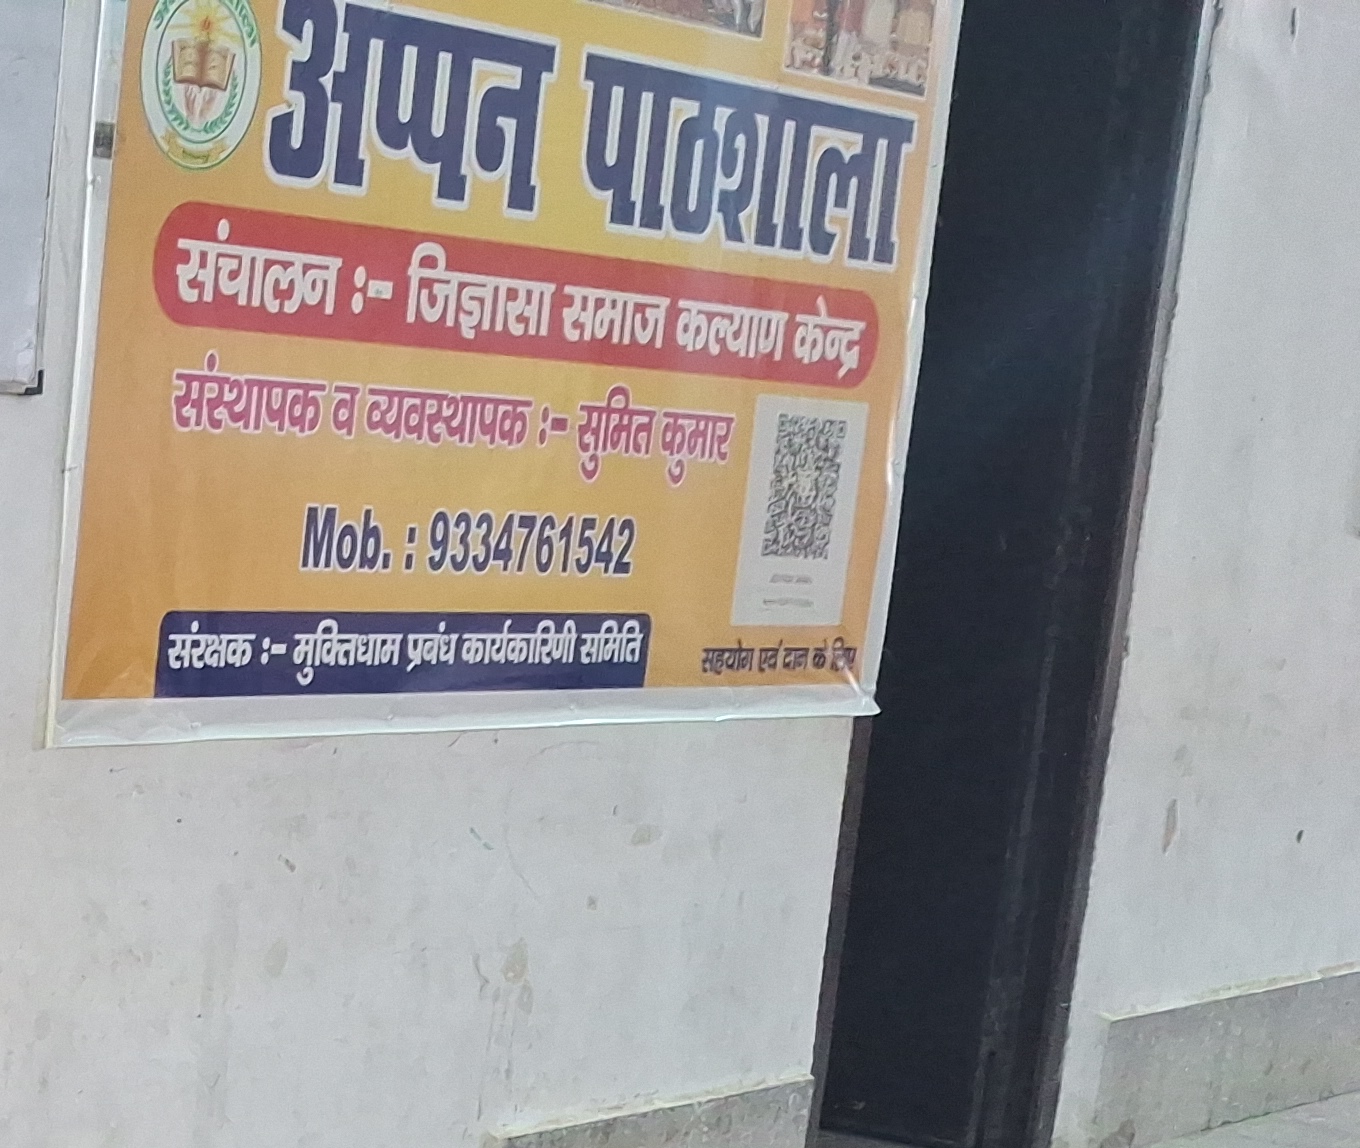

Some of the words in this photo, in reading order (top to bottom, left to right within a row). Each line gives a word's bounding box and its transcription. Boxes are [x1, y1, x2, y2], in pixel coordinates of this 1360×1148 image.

[266, 0, 558, 214] अप्पन
[581, 50, 918, 267] पाठशाला
[176, 217, 343, 316] संचालन
[405, 241, 557, 339] जिज्ञासा
[562, 284, 672, 349] समाज
[676, 299, 789, 362] कल्याण
[793, 294, 867, 380] केन्द्र
[173, 350, 329, 436] संस्थापक
[330, 382, 362, 438] व
[365, 385, 534, 449] व्यवस्थापक
[577, 382, 658, 483] सुमित
[659, 410, 736, 487] कुमार
[299, 504, 393, 572] Mob.
[427, 509, 637, 576] 9334761542
[167, 620, 257, 670] संरक्षक
[292, 618, 404, 686] मुक्तिधाम
[461, 618, 578, 665] कार्यकारिणी
[579, 619, 644, 665] समिति
[701, 639, 755, 676] सहयोग
